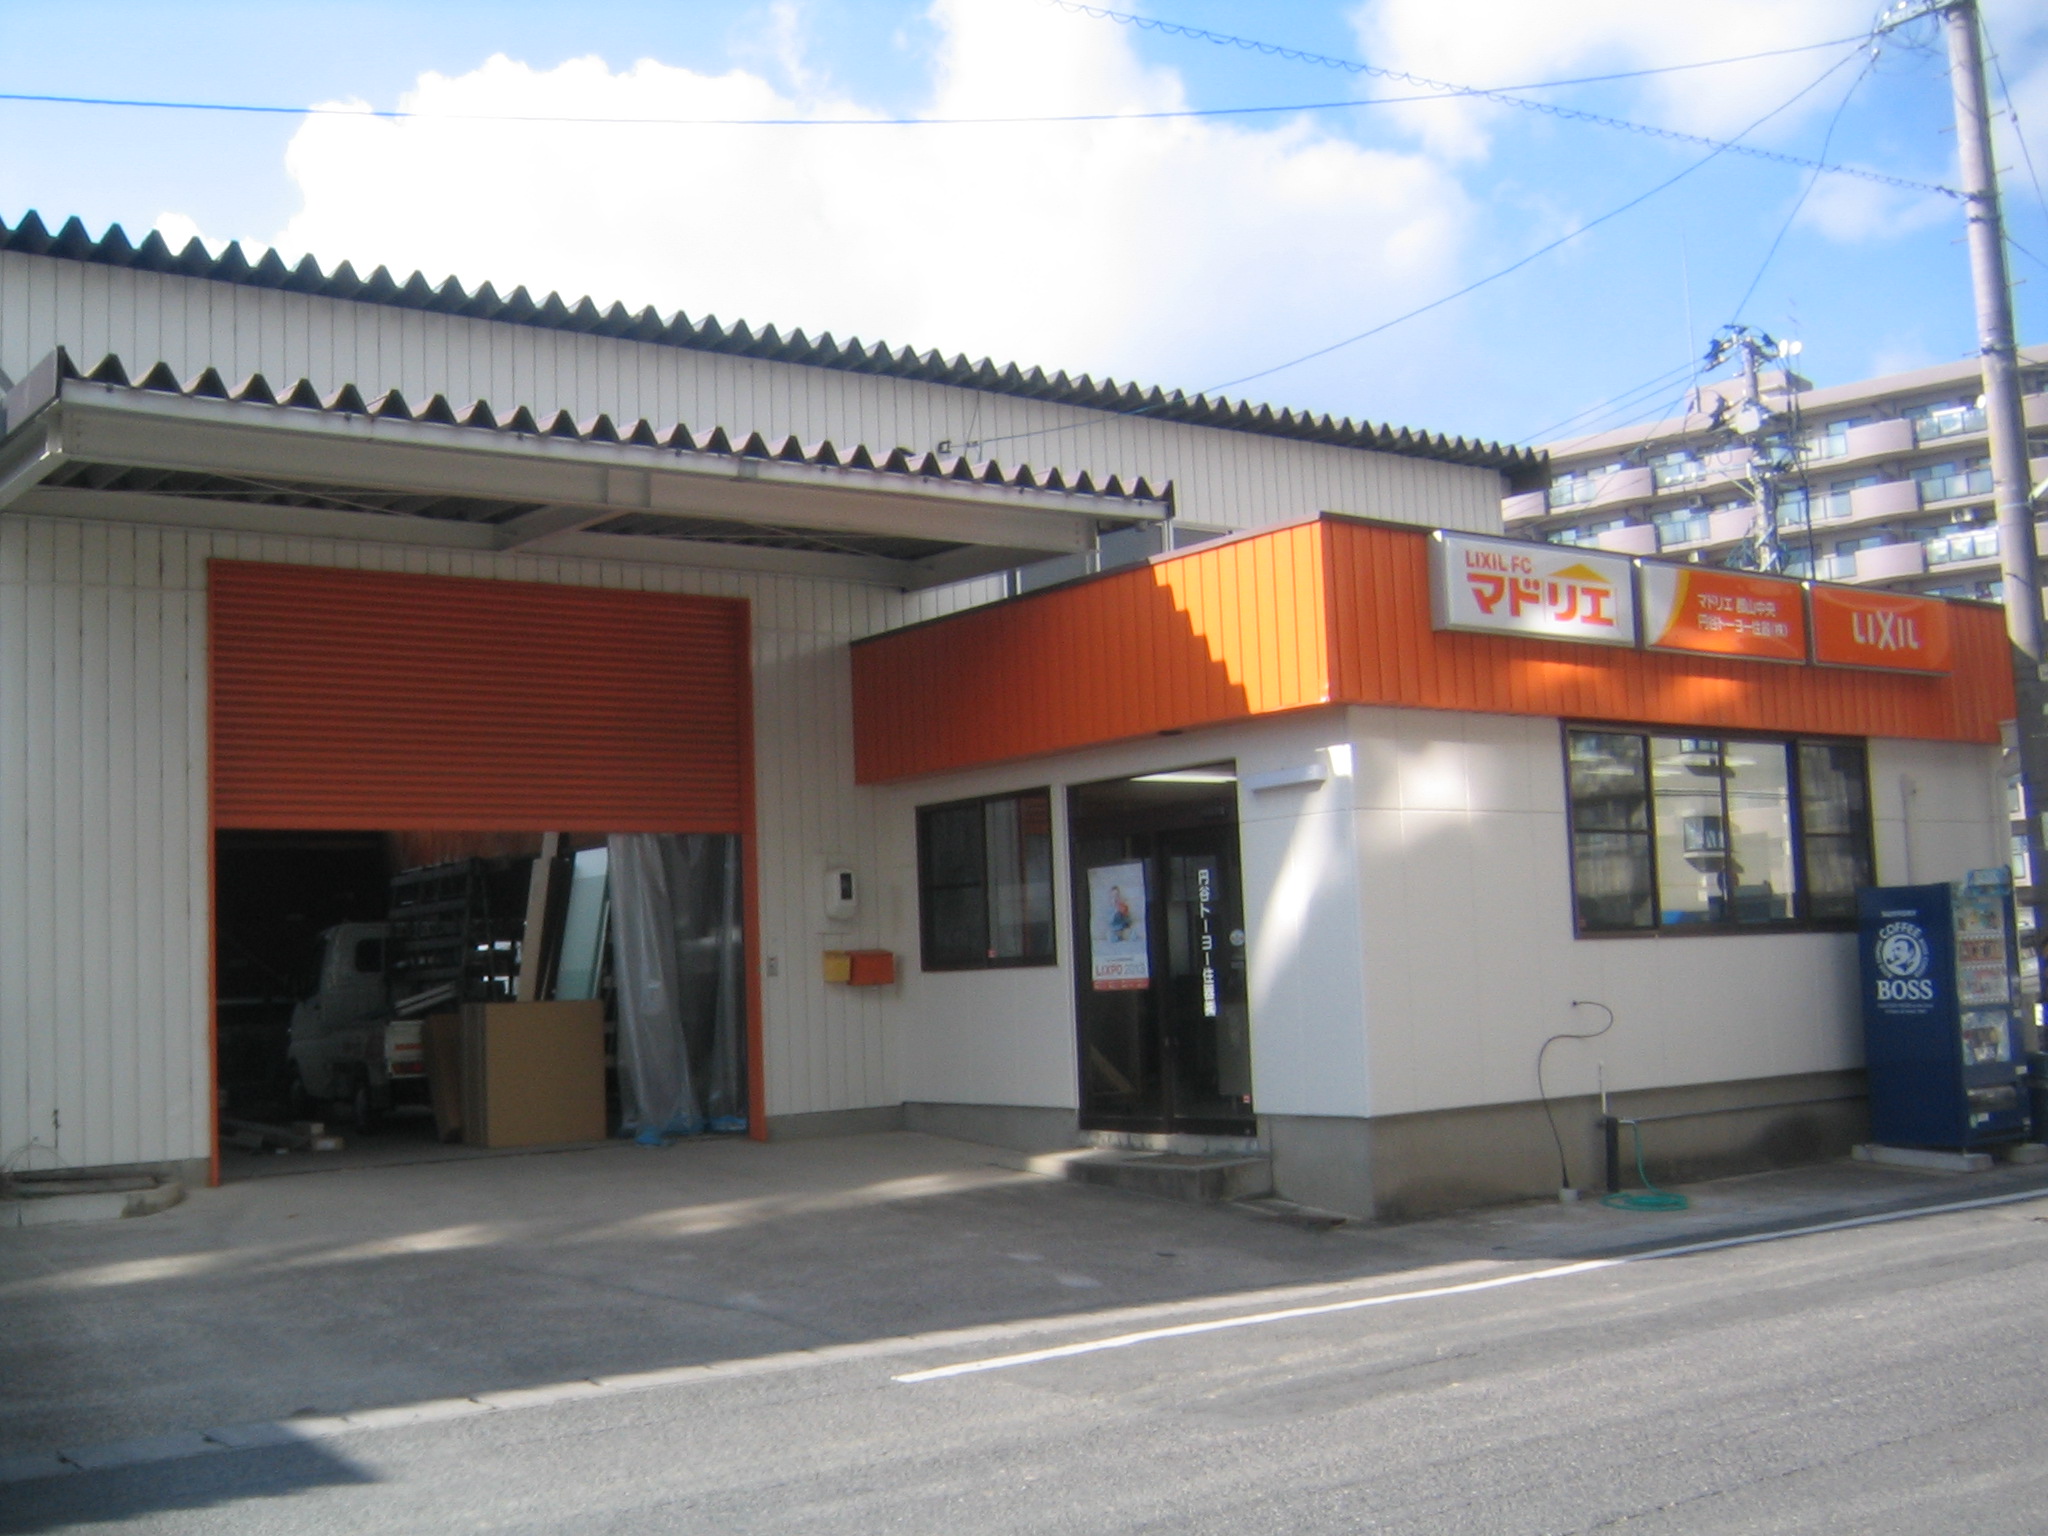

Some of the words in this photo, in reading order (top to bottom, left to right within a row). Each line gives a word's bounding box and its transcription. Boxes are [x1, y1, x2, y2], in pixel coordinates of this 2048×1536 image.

[1465, 550, 1508, 572] LIXIL
[1511, 556, 1533, 574] FC
[1466, 572, 1615, 627] マドリエ
[1851, 610, 1920, 651] LIXIL
[1876, 979, 1934, 1000] BOSS
